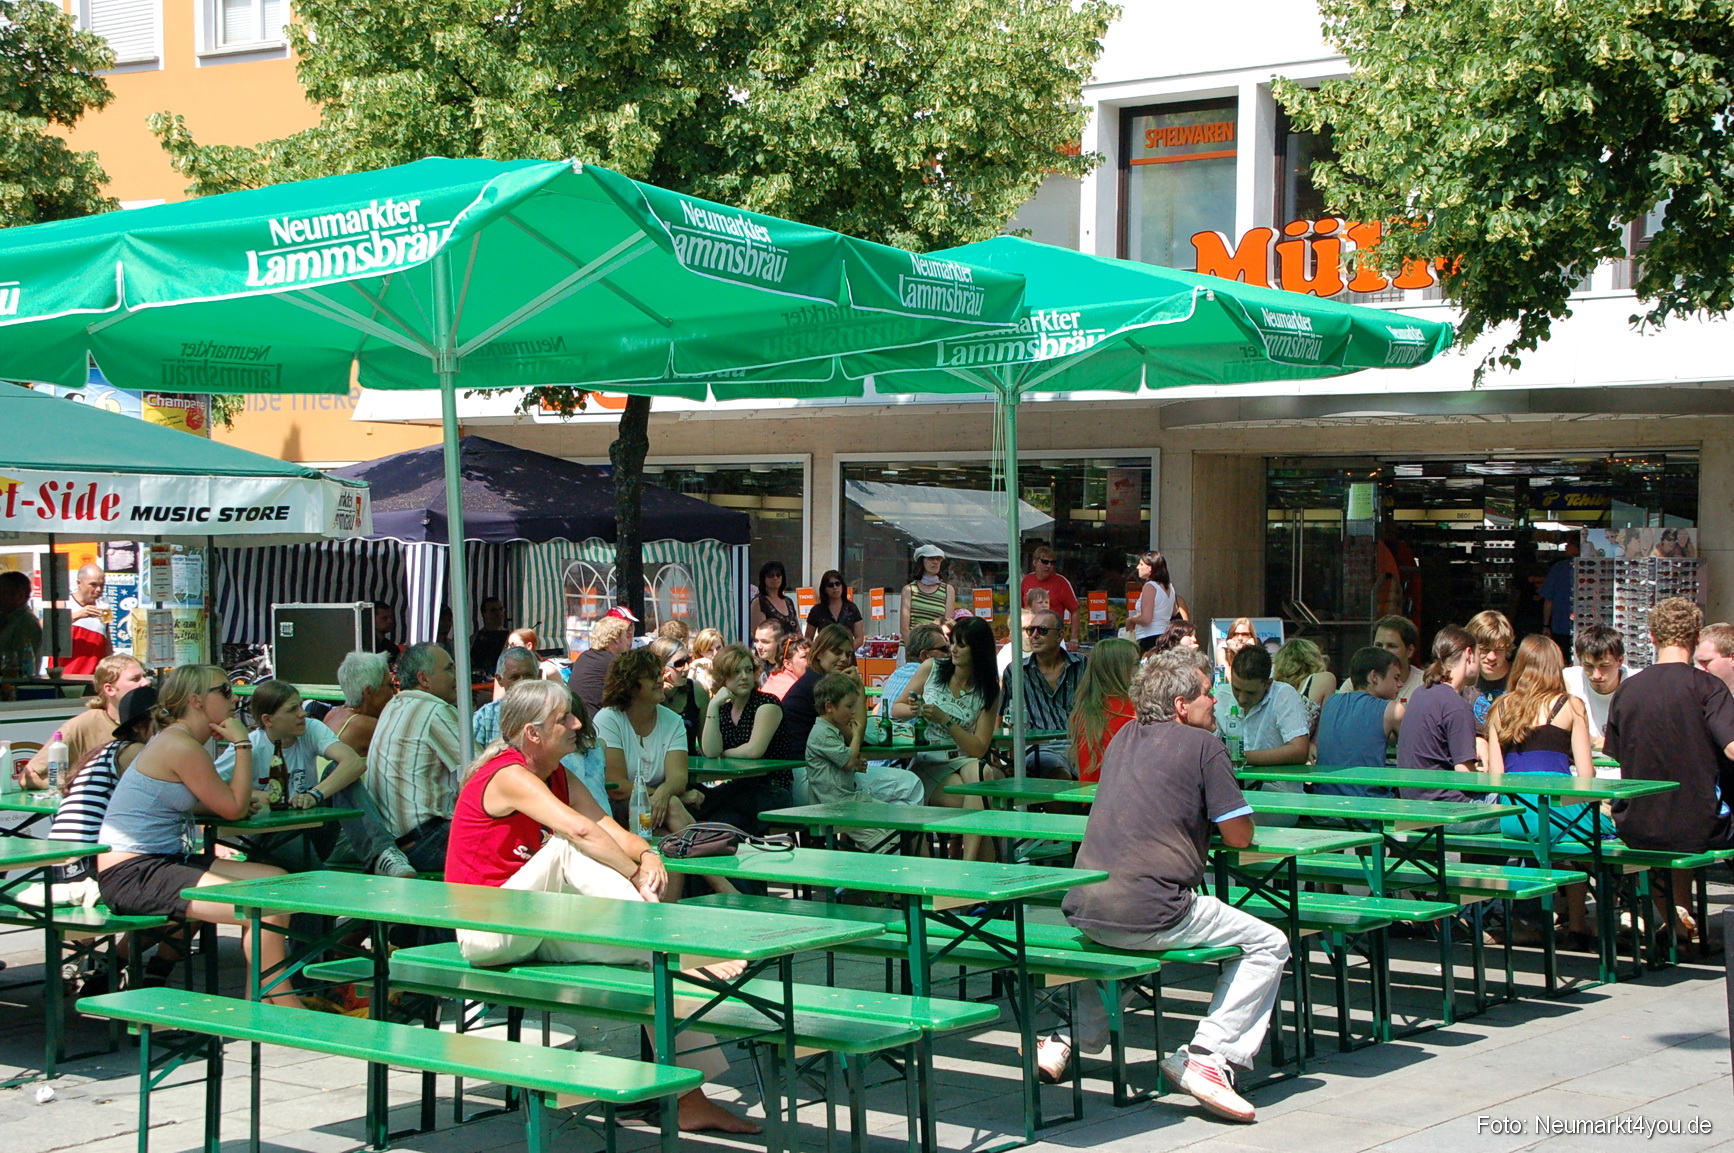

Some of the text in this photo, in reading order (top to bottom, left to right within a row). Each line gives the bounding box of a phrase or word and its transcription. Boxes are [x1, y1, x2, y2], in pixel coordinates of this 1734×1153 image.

[1144, 121, 1235, 148] SPIELWAREN
[269, 199, 421, 246] Neumarkter
[679, 199, 772, 243] Neumarkter
[245, 223, 449, 287] Lammsbräu
[909, 253, 973, 284] Neumarkter
[899, 274, 985, 316] Lammsbräu
[1261, 307, 1313, 331] Neumarkter
[1265, 330, 1323, 361] mmsbräu
[0, 480, 291, 522] t-Side MUSIC STORE
